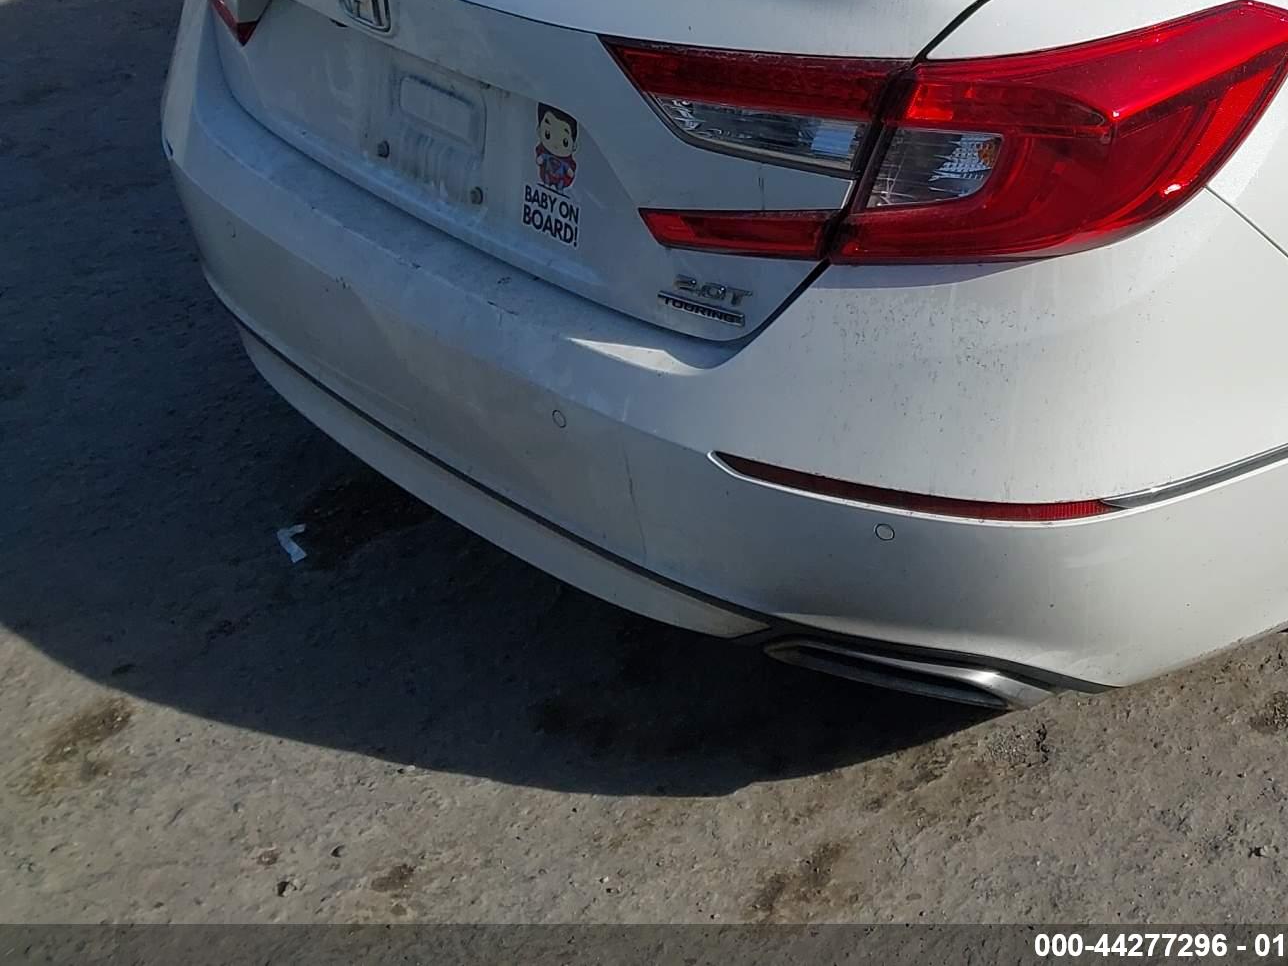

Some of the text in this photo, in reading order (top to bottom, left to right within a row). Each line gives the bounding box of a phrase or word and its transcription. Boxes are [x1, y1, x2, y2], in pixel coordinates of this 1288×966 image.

[525, 185, 579, 224] BABY ON
[523, 204, 578, 247] BOARD!
[663, 296, 743, 324] TOURING
